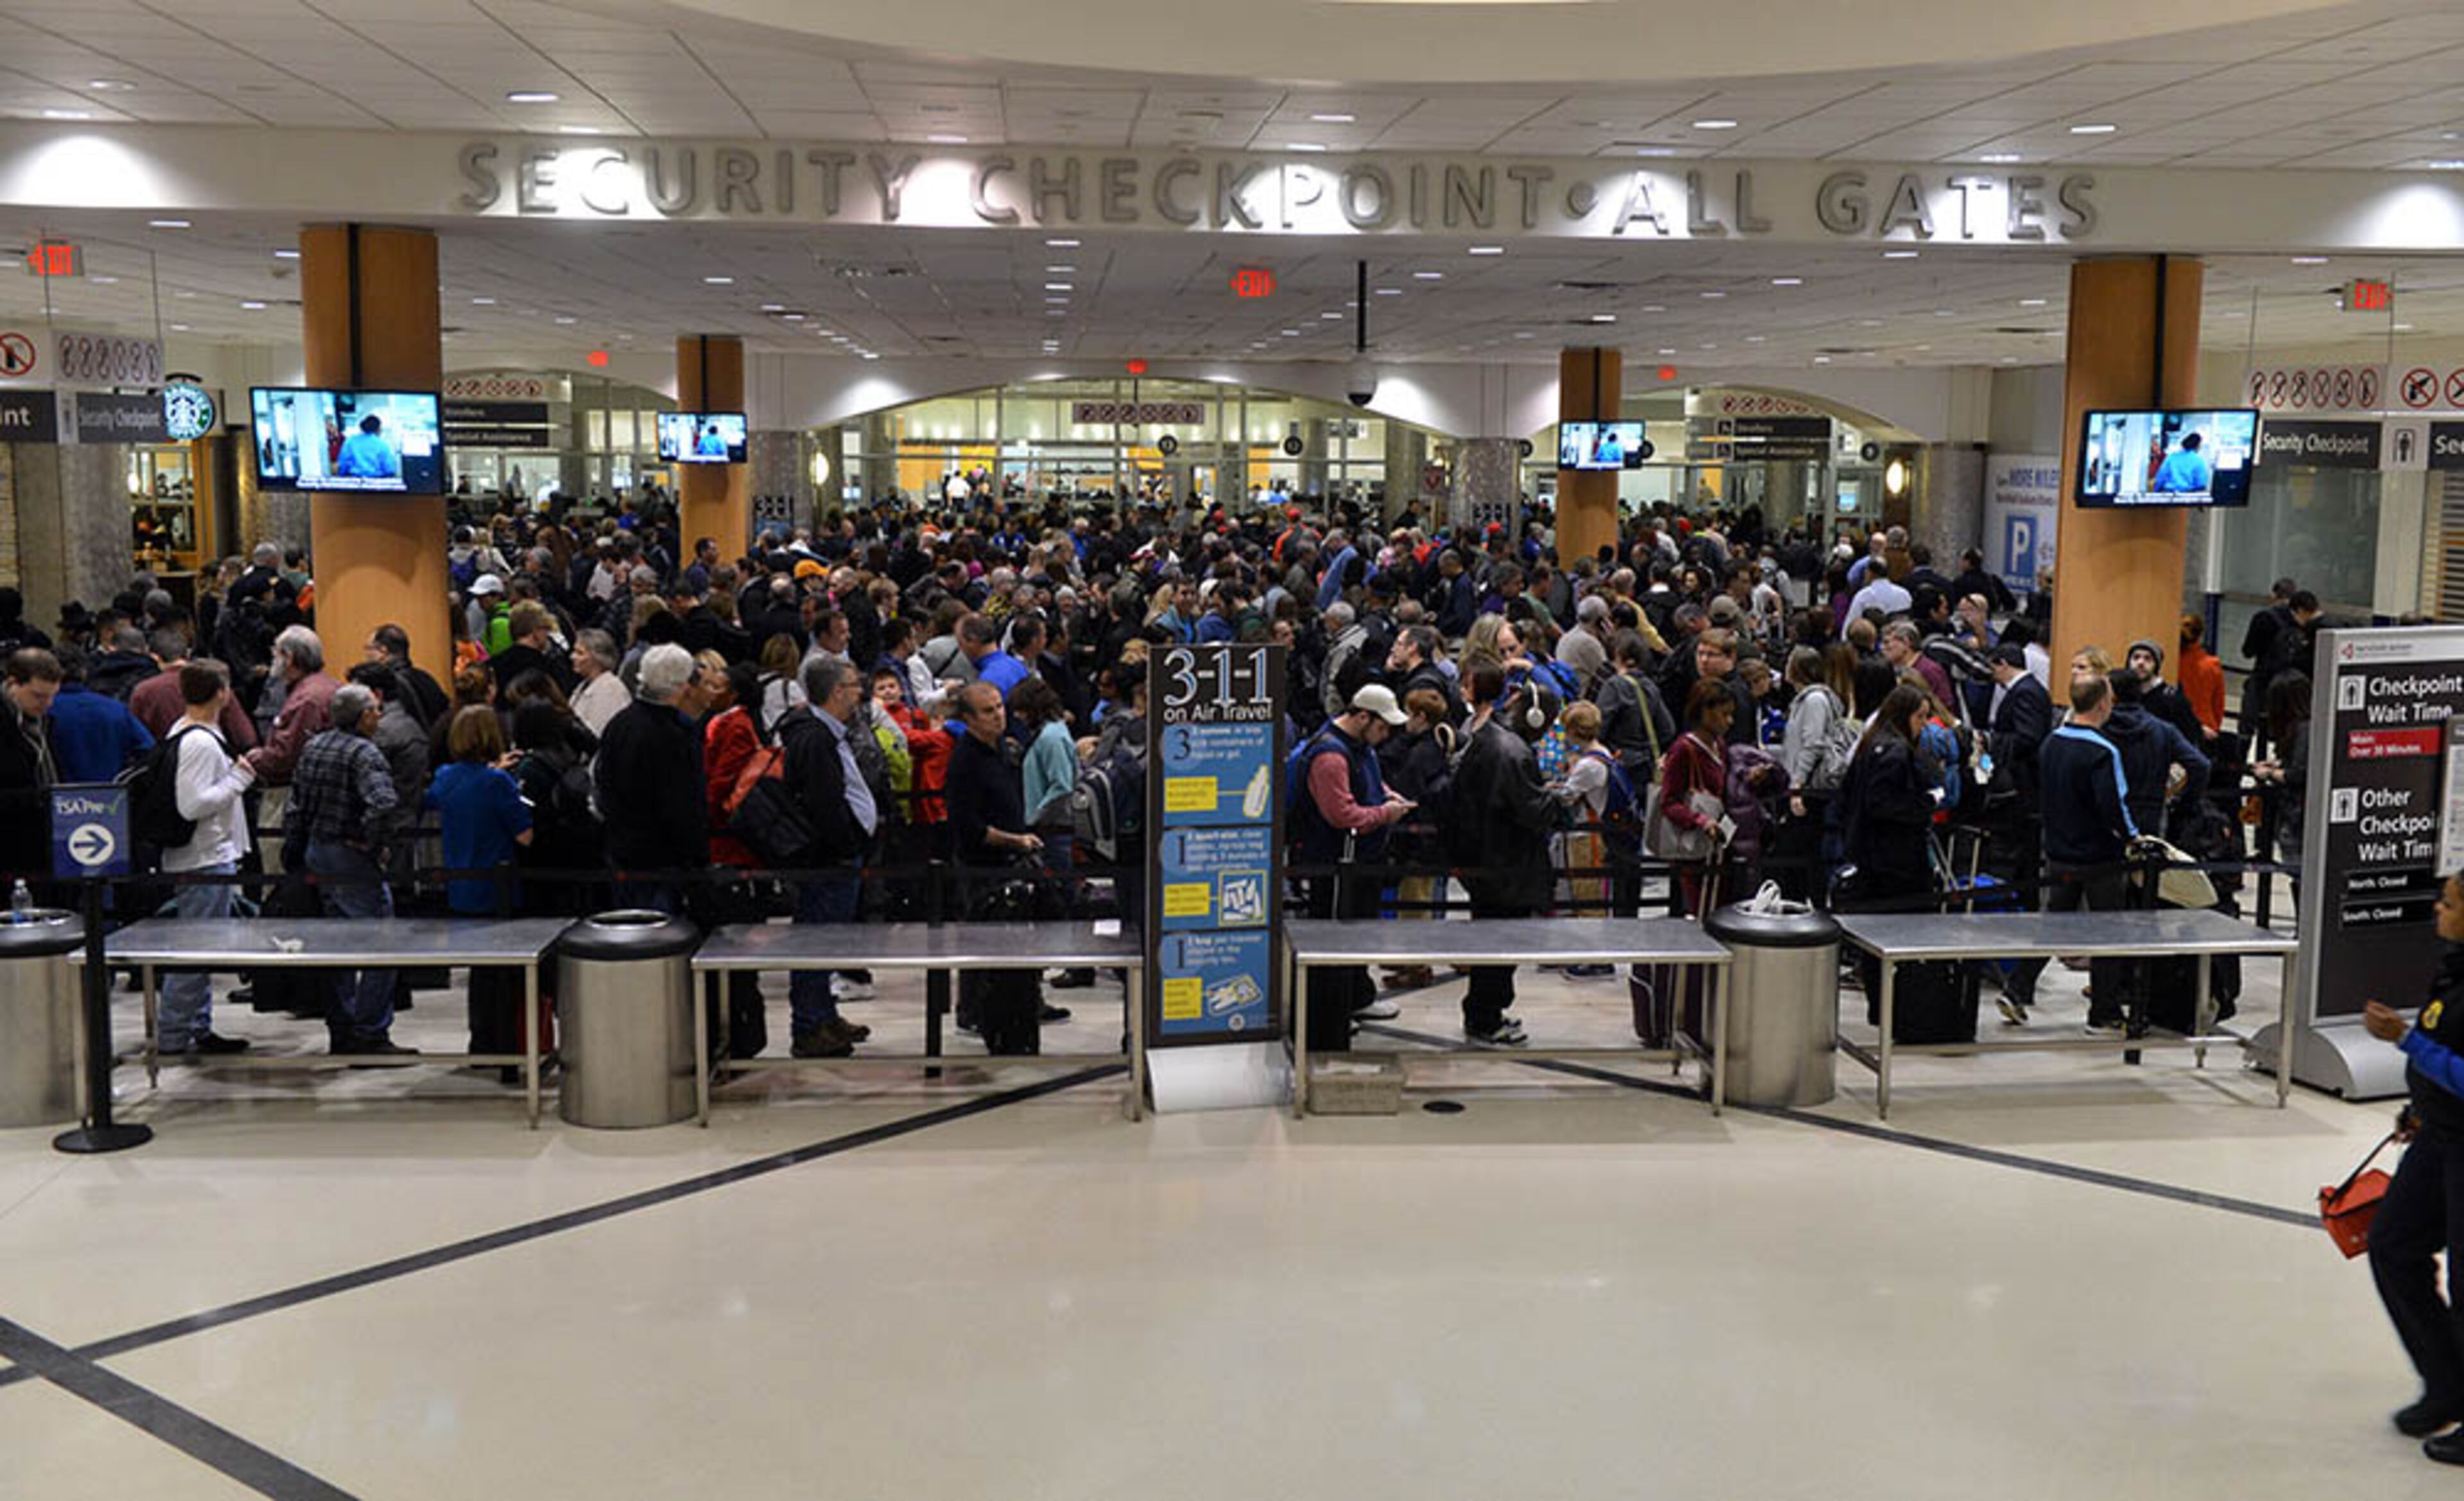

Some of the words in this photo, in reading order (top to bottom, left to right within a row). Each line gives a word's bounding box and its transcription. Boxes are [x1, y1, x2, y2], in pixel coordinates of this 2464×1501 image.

[458, 145, 922, 221] SECURITY
[971, 155, 1553, 233] CHECKPOINT
[1613, 168, 1771, 237] ALL
[1815, 171, 2100, 241] GATES
[1238, 269, 1270, 297] EXIT
[2354, 282, 2387, 311] EXIT
[2263, 433, 2304, 455] Security
[2306, 433, 2368, 454] Checkpoint
[2011, 521, 2030, 574] P
[1163, 648, 1273, 706] 3-1-1
[2369, 674, 2463, 698] Checkpoint
[1163, 707, 1187, 722] on
[1191, 703, 1217, 721] Air
[1221, 703, 1272, 719] Travel
[2367, 702, 2407, 724] Wait
[1174, 729, 1191, 760] 3
[2362, 788, 2411, 808] Other
[2359, 811, 2436, 836] Checkpoi
[2358, 841, 2397, 861] Wait
[2404, 838, 2433, 858] Tim
[2377, 876, 2408, 888] Closed
[2372, 907, 2402, 920] Closed
